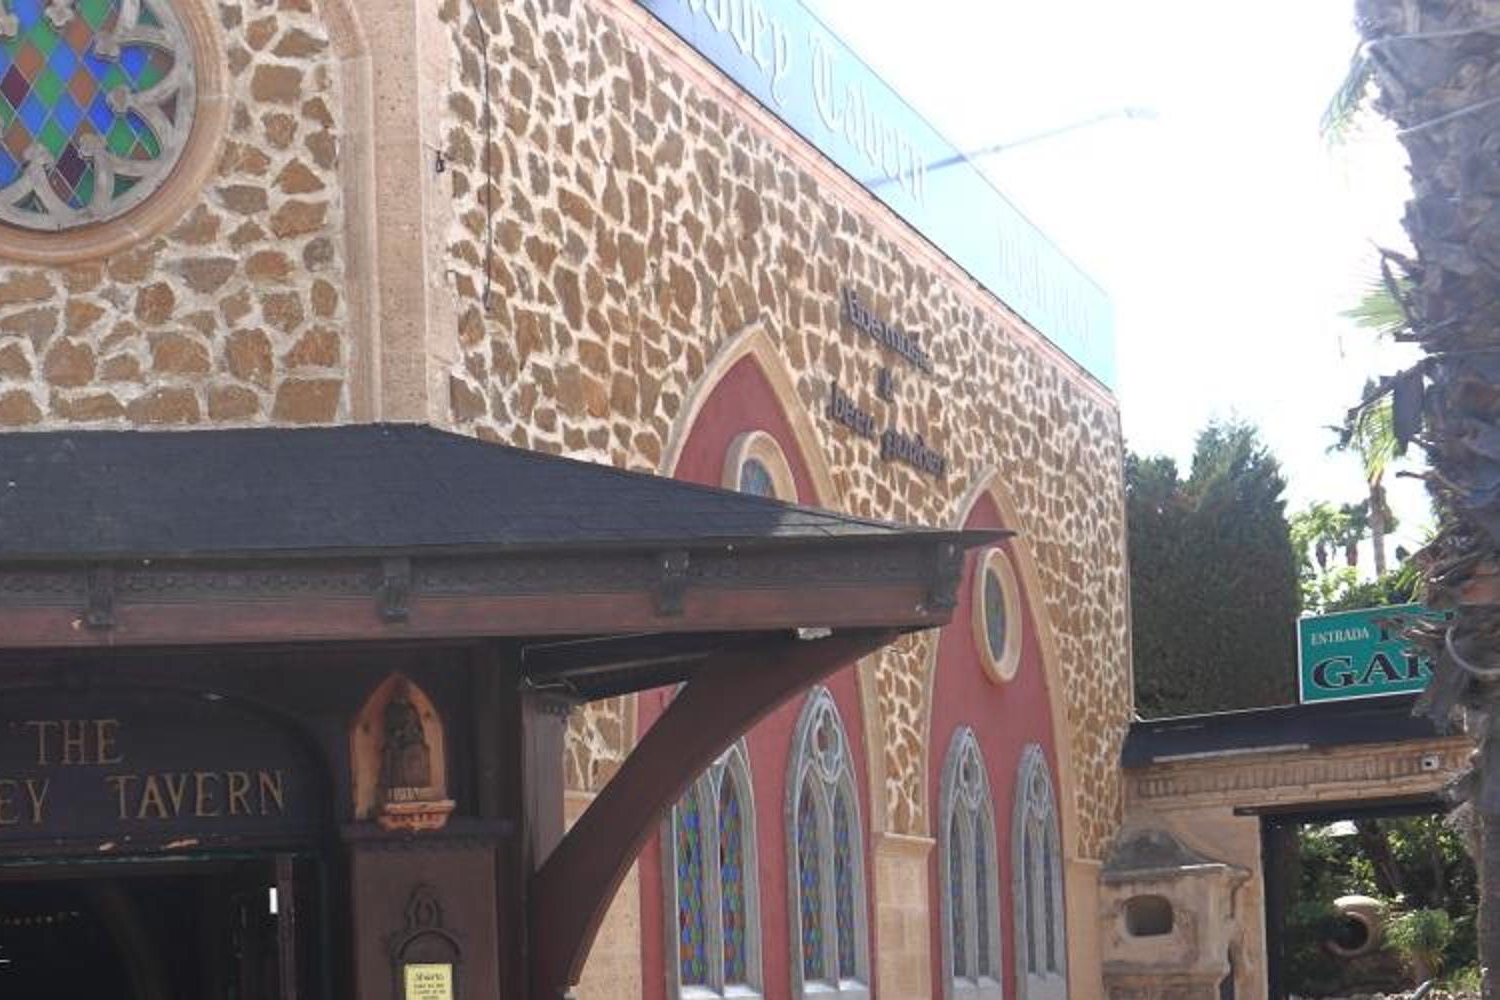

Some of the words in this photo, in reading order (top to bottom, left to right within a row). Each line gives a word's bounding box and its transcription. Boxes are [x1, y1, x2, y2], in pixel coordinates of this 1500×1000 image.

[1311, 627, 1369, 647] ENTRADA
[26, 718, 126, 765] THE
[105, 769, 288, 819] TAVERN
